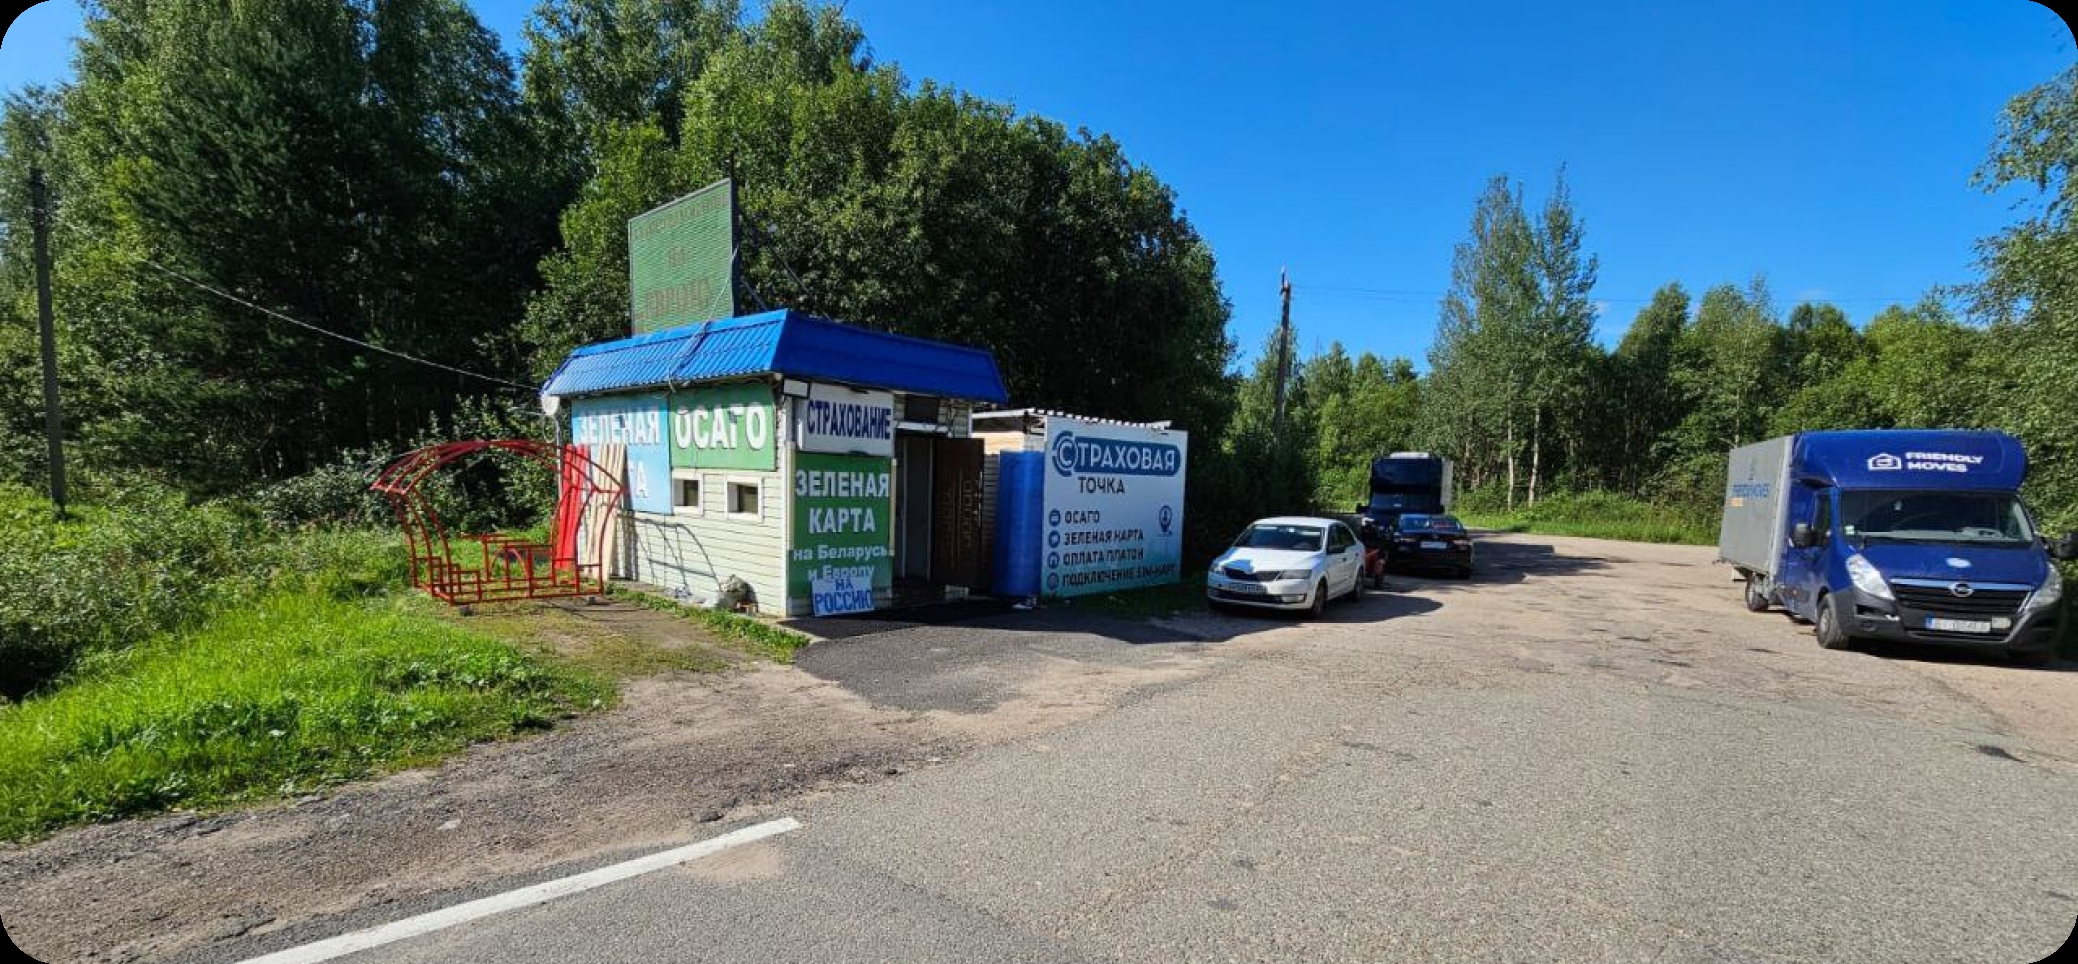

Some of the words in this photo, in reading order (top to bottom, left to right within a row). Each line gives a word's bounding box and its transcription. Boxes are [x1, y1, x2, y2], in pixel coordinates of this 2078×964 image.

[579, 406, 661, 446] ЗЕЛЕНАЯ
[674, 401, 767, 450] ОСАГО
[806, 400, 892, 440] СТРАХОВАНИЕ
[1059, 441, 1176, 471] СТРАХОВАЯ
[1905, 451, 1984, 465] FRIENDLY
[1907, 461, 1968, 473] MOVES
[796, 468, 890, 498] ЗЕЛЕНАЯ
[1077, 475, 1126, 494] ТОЧКА
[808, 507, 877, 534] КАРТА
[1064, 510, 1101, 525] ОСАГО
[1064, 529, 1112, 546] ЗЕЛЕНАЯ
[793, 549, 813, 561] на
[817, 544, 888, 562] Беларусь
[1063, 550, 1104, 567] ОПЛАТА
[808, 569, 818, 582] и
[822, 564, 876, 580] Европу
[835, 579, 854, 592] НА
[814, 590, 873, 615] РОССИЮ
